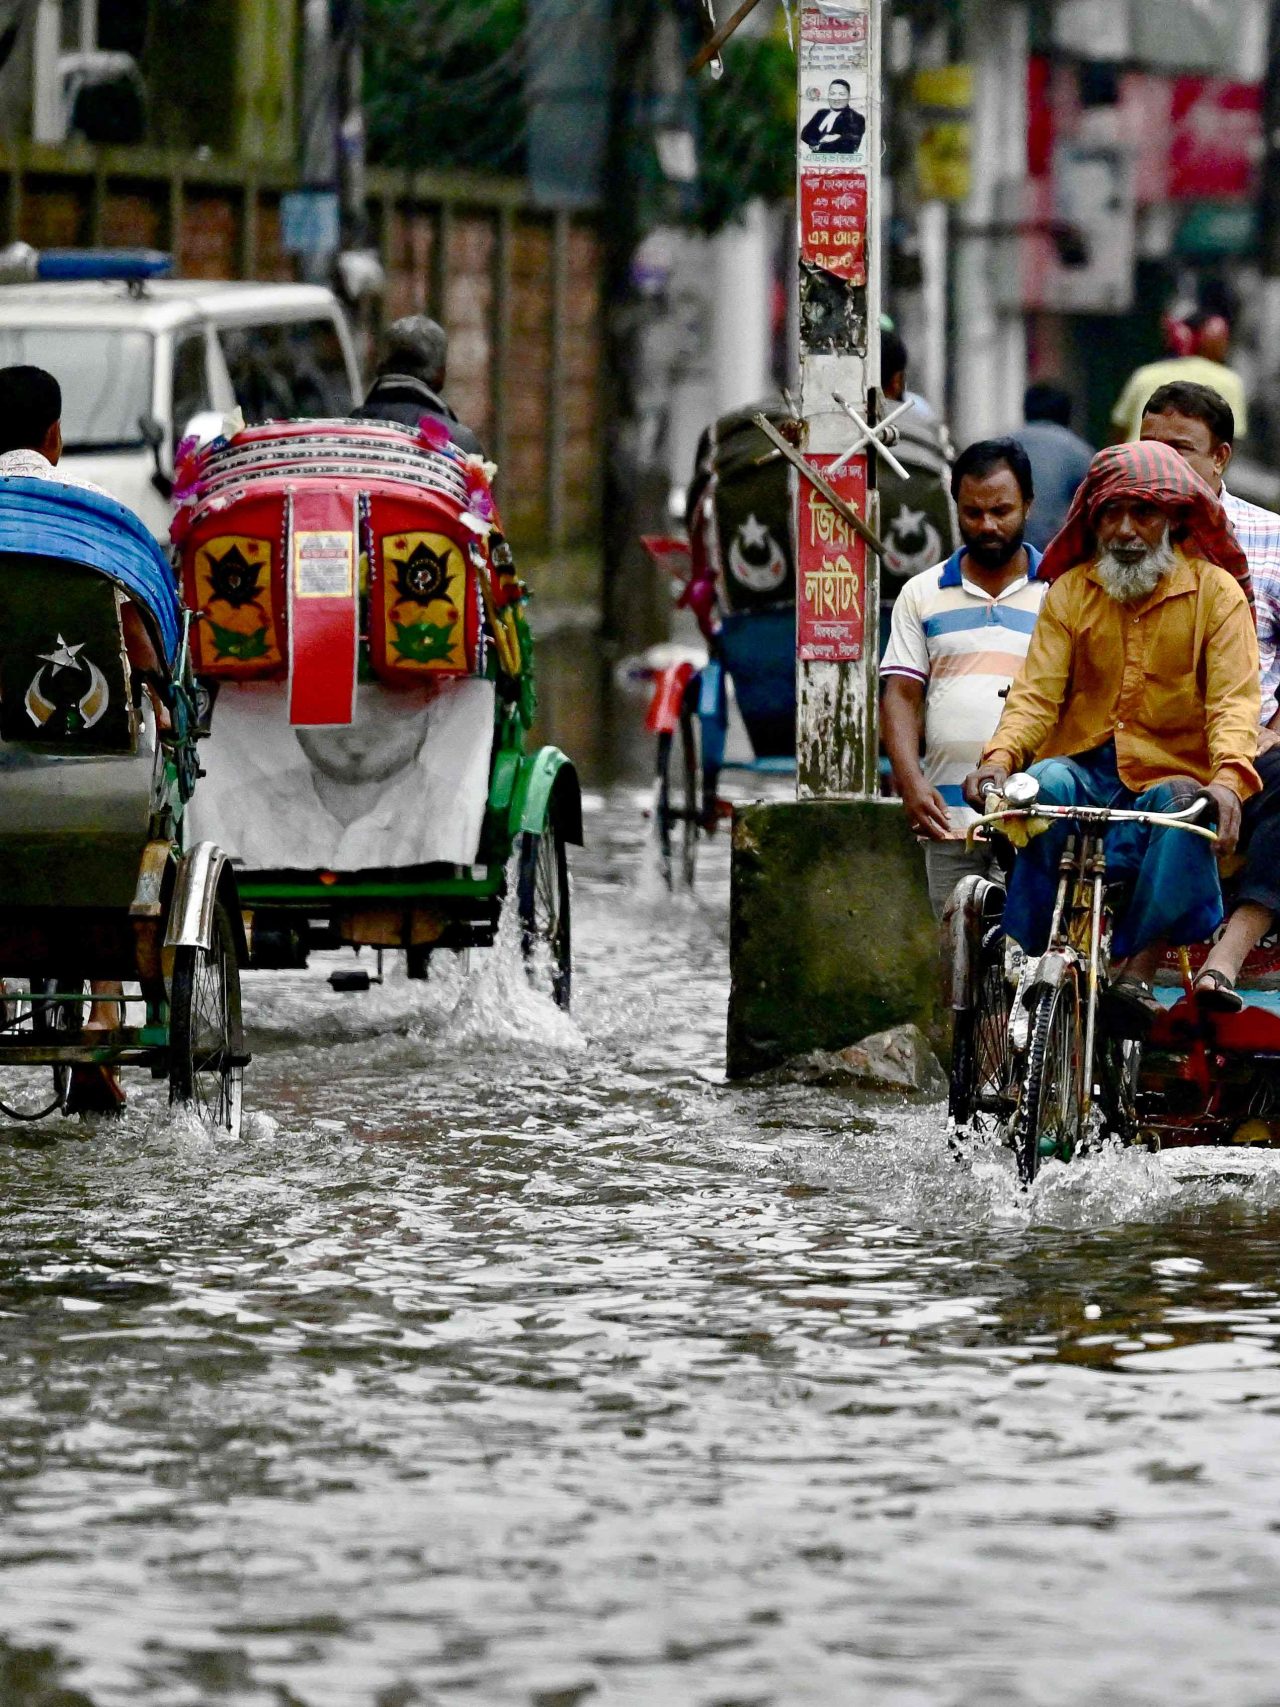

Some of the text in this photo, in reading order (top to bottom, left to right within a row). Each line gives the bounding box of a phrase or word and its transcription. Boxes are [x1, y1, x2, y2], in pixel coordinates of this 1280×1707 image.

[808, 231, 860, 247] এস আর
[804, 555, 861, 619] লাইটিং
